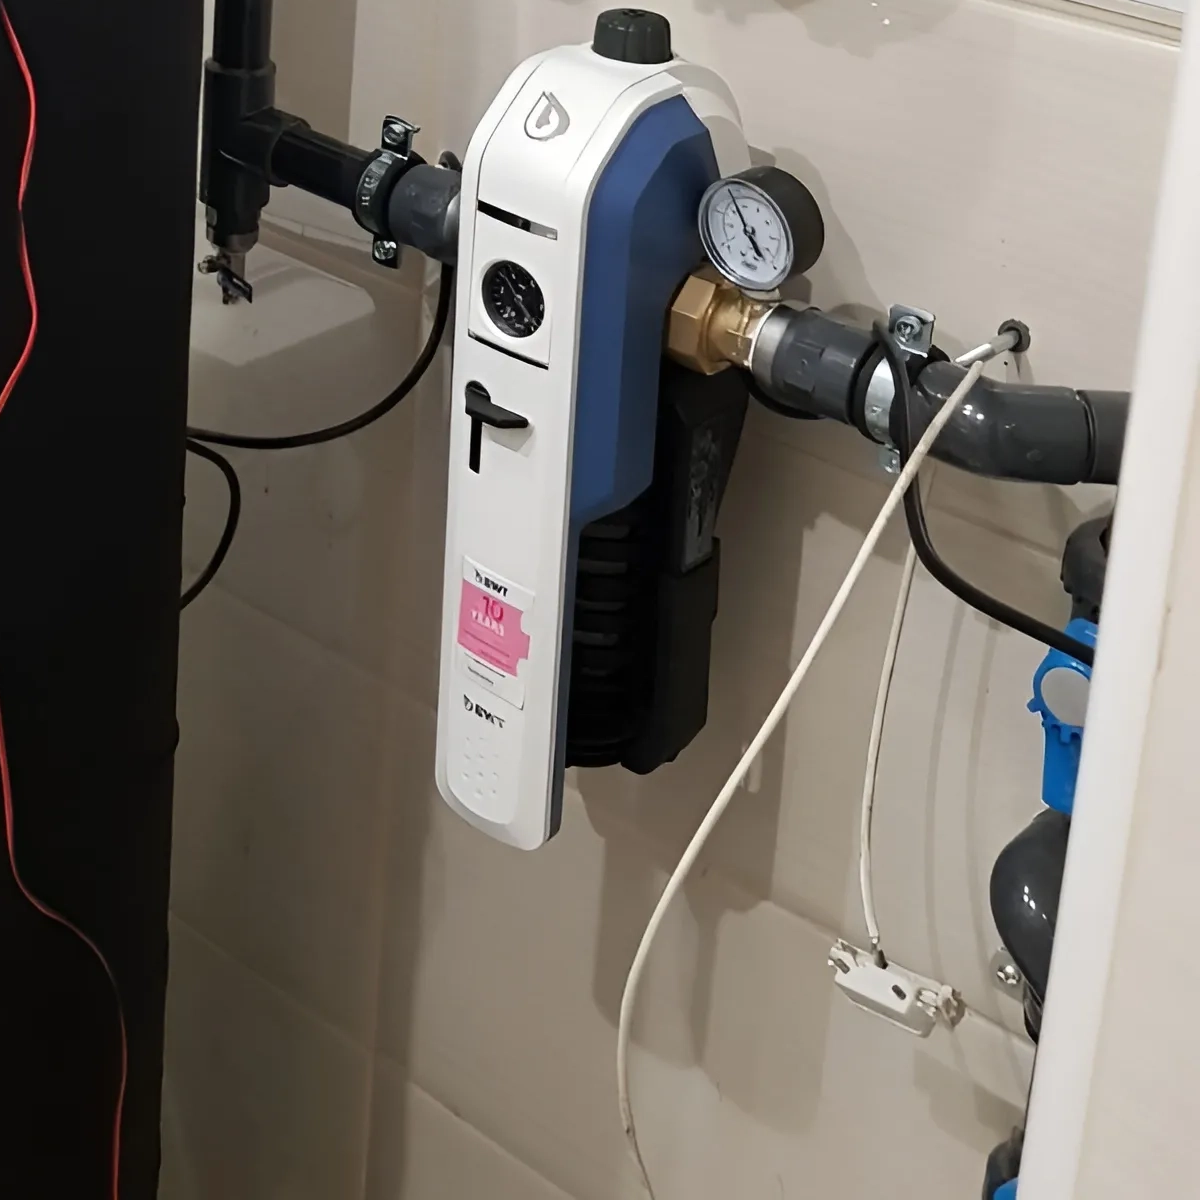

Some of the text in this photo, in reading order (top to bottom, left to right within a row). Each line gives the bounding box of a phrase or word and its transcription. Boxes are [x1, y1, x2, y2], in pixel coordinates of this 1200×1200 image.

[484, 576, 509, 597] BWT
[482, 595, 504, 623] 10
[471, 609, 505, 637] YEARS
[474, 703, 506, 729] BWT
